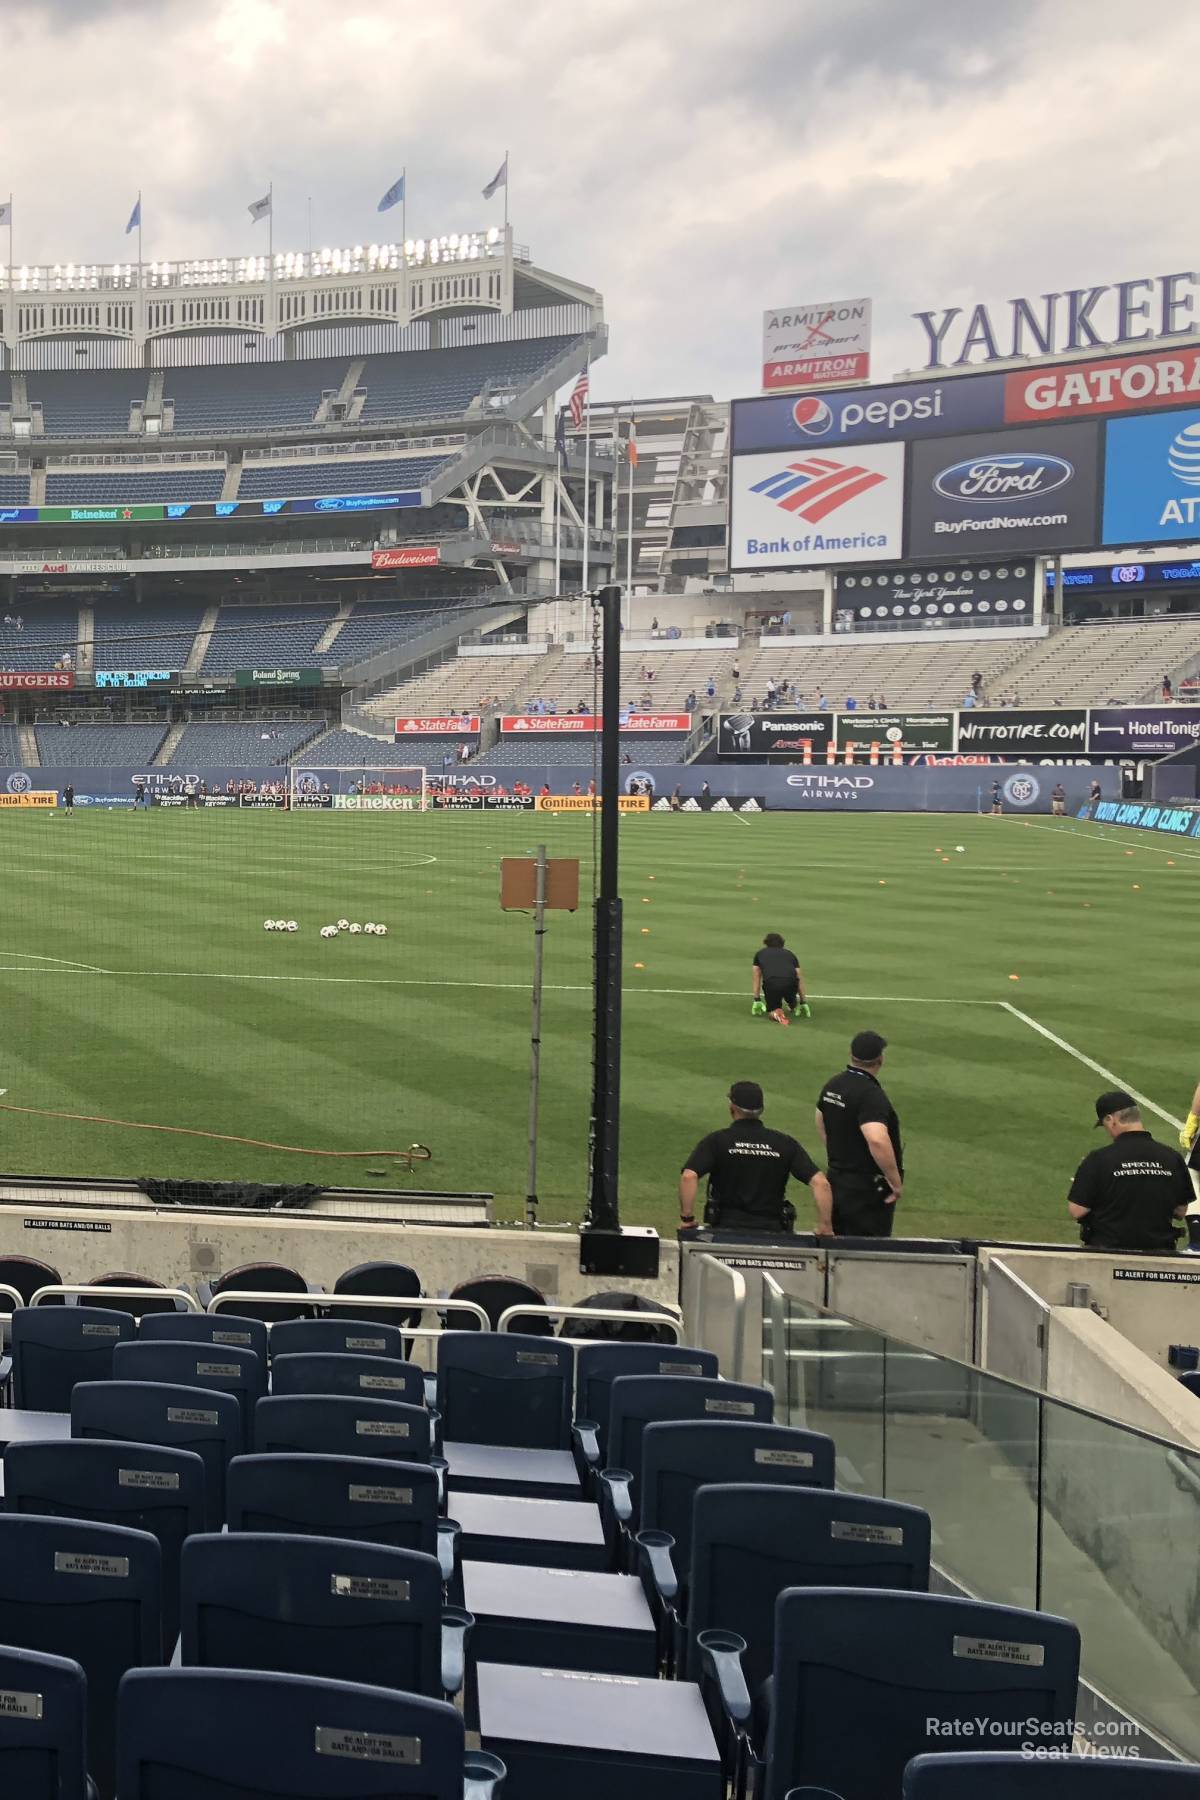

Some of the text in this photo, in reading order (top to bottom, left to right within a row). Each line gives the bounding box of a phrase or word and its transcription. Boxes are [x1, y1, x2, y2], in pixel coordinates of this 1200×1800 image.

[767, 307, 865, 330] ARMITRON
[771, 357, 858, 377] ARMITRON
[812, 368, 856, 380] WATCHES
[840, 389, 943, 433] pepsi
[960, 461, 1045, 496] Ford
[167, 507, 185, 517] SAP
[215, 505, 233, 515] SAP
[263, 503, 280, 513] SAP
[71, 509, 117, 519] Heineken
[933, 512, 1068, 535] BuyFordNow.com
[746, 532, 888, 555] Bank of America
[374, 553, 436, 567] Budweiser
[42, 564, 68, 573] Audi
[70, 563, 105, 572] YANKEES
[106, 563, 128, 572] CLUB
[934, 585, 974, 601] Yankees
[95, 671, 171, 680] ENDLESS THINKING
[252, 670, 300, 681] Poland Spring
[95, 679, 148, 688] IN TO DOING
[761, 720, 825, 732] Panasonic
[958, 722, 1085, 741] NITTOTIRE.COM
[131, 774, 199, 784] ETIHAD
[786, 775, 875, 788] ETIHAD
[801, 790, 858, 799] AIRWAYS
[33, 796, 54, 804] TIRE
[334, 795, 413, 809] Heineken
[436, 796, 480, 804] ETIHAD
[487, 796, 532, 804] ETIHAD
[619, 799, 645, 808] TIRE
[1094, 801, 1193, 832] YOUTH CAMPS AND CLINICS
[735, 1142, 772, 1150] SPECIAL
[728, 1149, 781, 1158] OPERATIONS
[1121, 1161, 1163, 1169] SPECIAL
[1113, 1169, 1173, 1177] OPERATIONS
[784, 1261, 802, 1269] BALLS
[7, 1704, 28, 1713] BALLS
